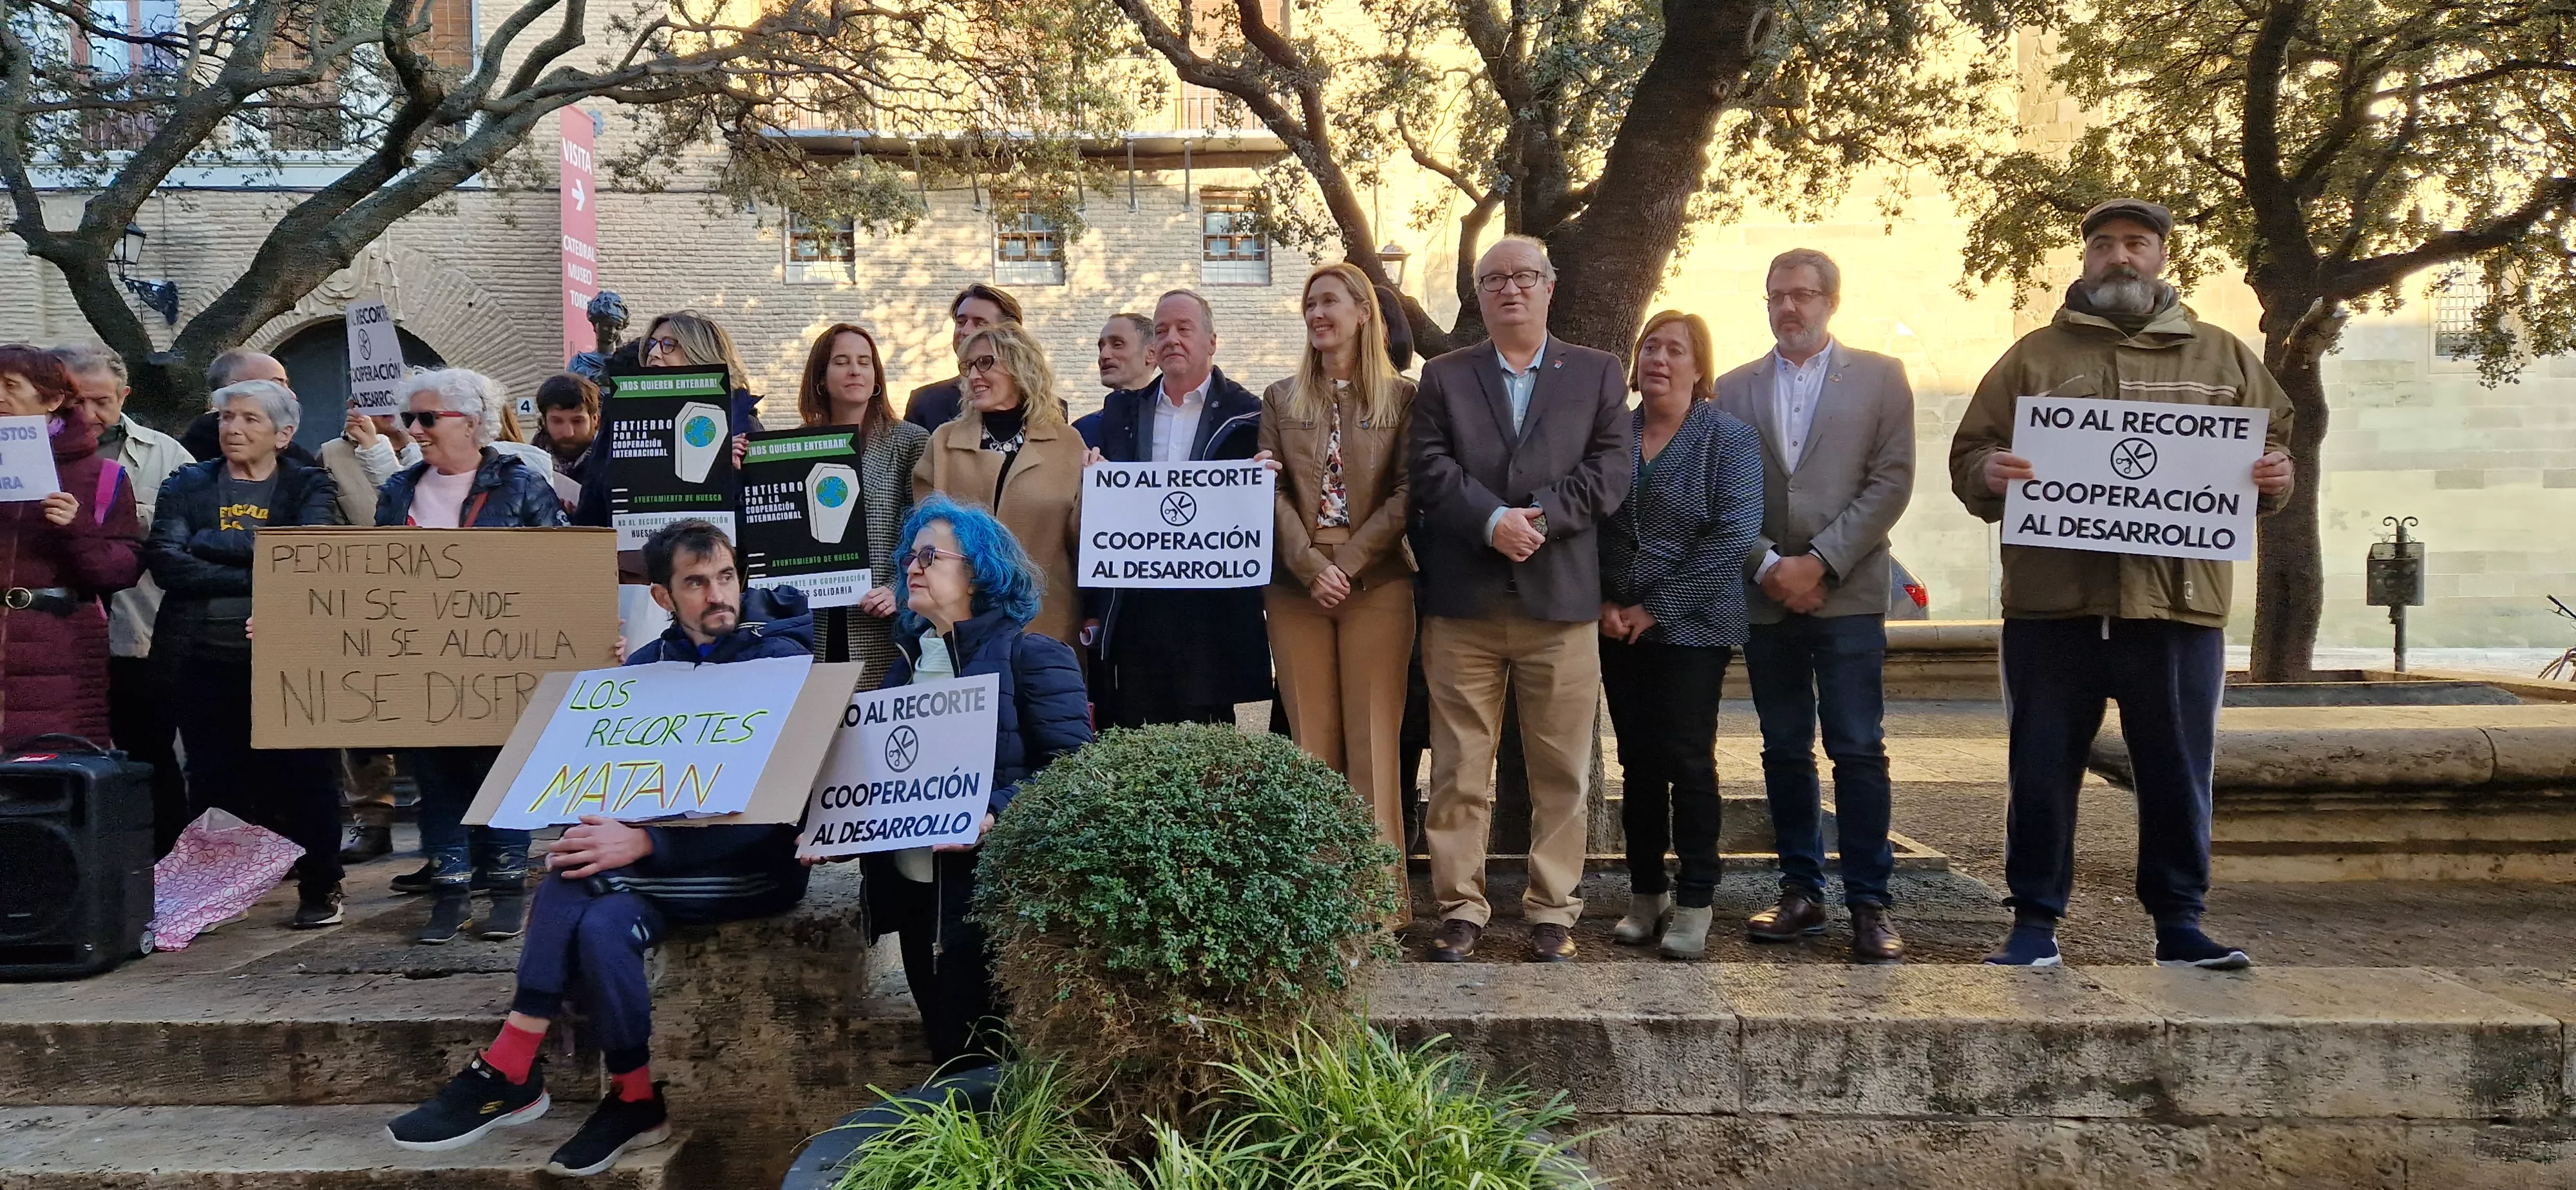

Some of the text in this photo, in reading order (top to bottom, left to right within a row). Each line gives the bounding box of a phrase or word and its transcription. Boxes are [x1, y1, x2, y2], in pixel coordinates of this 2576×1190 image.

[562, 137, 592, 175] VISITA
[564, 234, 595, 263] CATEDRAL
[568, 262, 592, 285] MUSEO
[352, 357, 401, 383] OOPERACIÓN
[641, 379, 673, 390] QUIEREN
[676, 378, 717, 388] ENTERRAR!
[520, 400, 531, 412] 4
[613, 419, 672, 431] ENTIERRO
[2030, 406, 2250, 440] NO AL RECORTE
[612, 439, 662, 449] COOPERACIÓN
[612, 449, 668, 458] INTERNACIONAL
[769, 442, 801, 453] QUIEREN
[804, 439, 846, 451] ENTERRAR!
[0, 477, 23, 489] RA
[1096, 468, 1262, 488] NO AL RECORTE
[634, 495, 682, 503] AYUNTAMIENTO
[744, 482, 803, 496] ENTIERRO
[2022, 479, 2240, 515] COOPERACIÓN
[745, 495, 780, 505] POR LA
[746, 501, 795, 515] COOPERACIÓN
[746, 511, 802, 524] INTERNACIONAL
[631, 529, 656, 538] HUES
[1092, 525, 1260, 549] COOPERACIÓN
[2018, 513, 2235, 550] AL DESARROLLO
[272, 543, 463, 580] PERIFERIAS
[772, 556, 821, 567] AYUNTAMIENTO
[834, 552, 859, 562] HUESCA
[1092, 559, 1261, 579] AL DESARROLLO
[820, 573, 866, 585] COOPERACIÓN
[813, 586, 852, 597] SOLIDARIA
[309, 589, 521, 620] NI SE VENDE
[343, 628, 577, 661] NI SE ALQUILA
[279, 668, 325, 728] NI
[337, 670, 401, 722] SE
[568, 679, 637, 711] LOS
[839, 686, 985, 728] O AL RECORTE
[585, 710, 769, 748] RECORTES
[526, 760, 724, 815] MATAN
[821, 766, 980, 810] COOPERACIÓN
[810, 811, 972, 847] AL DESARROLLO
